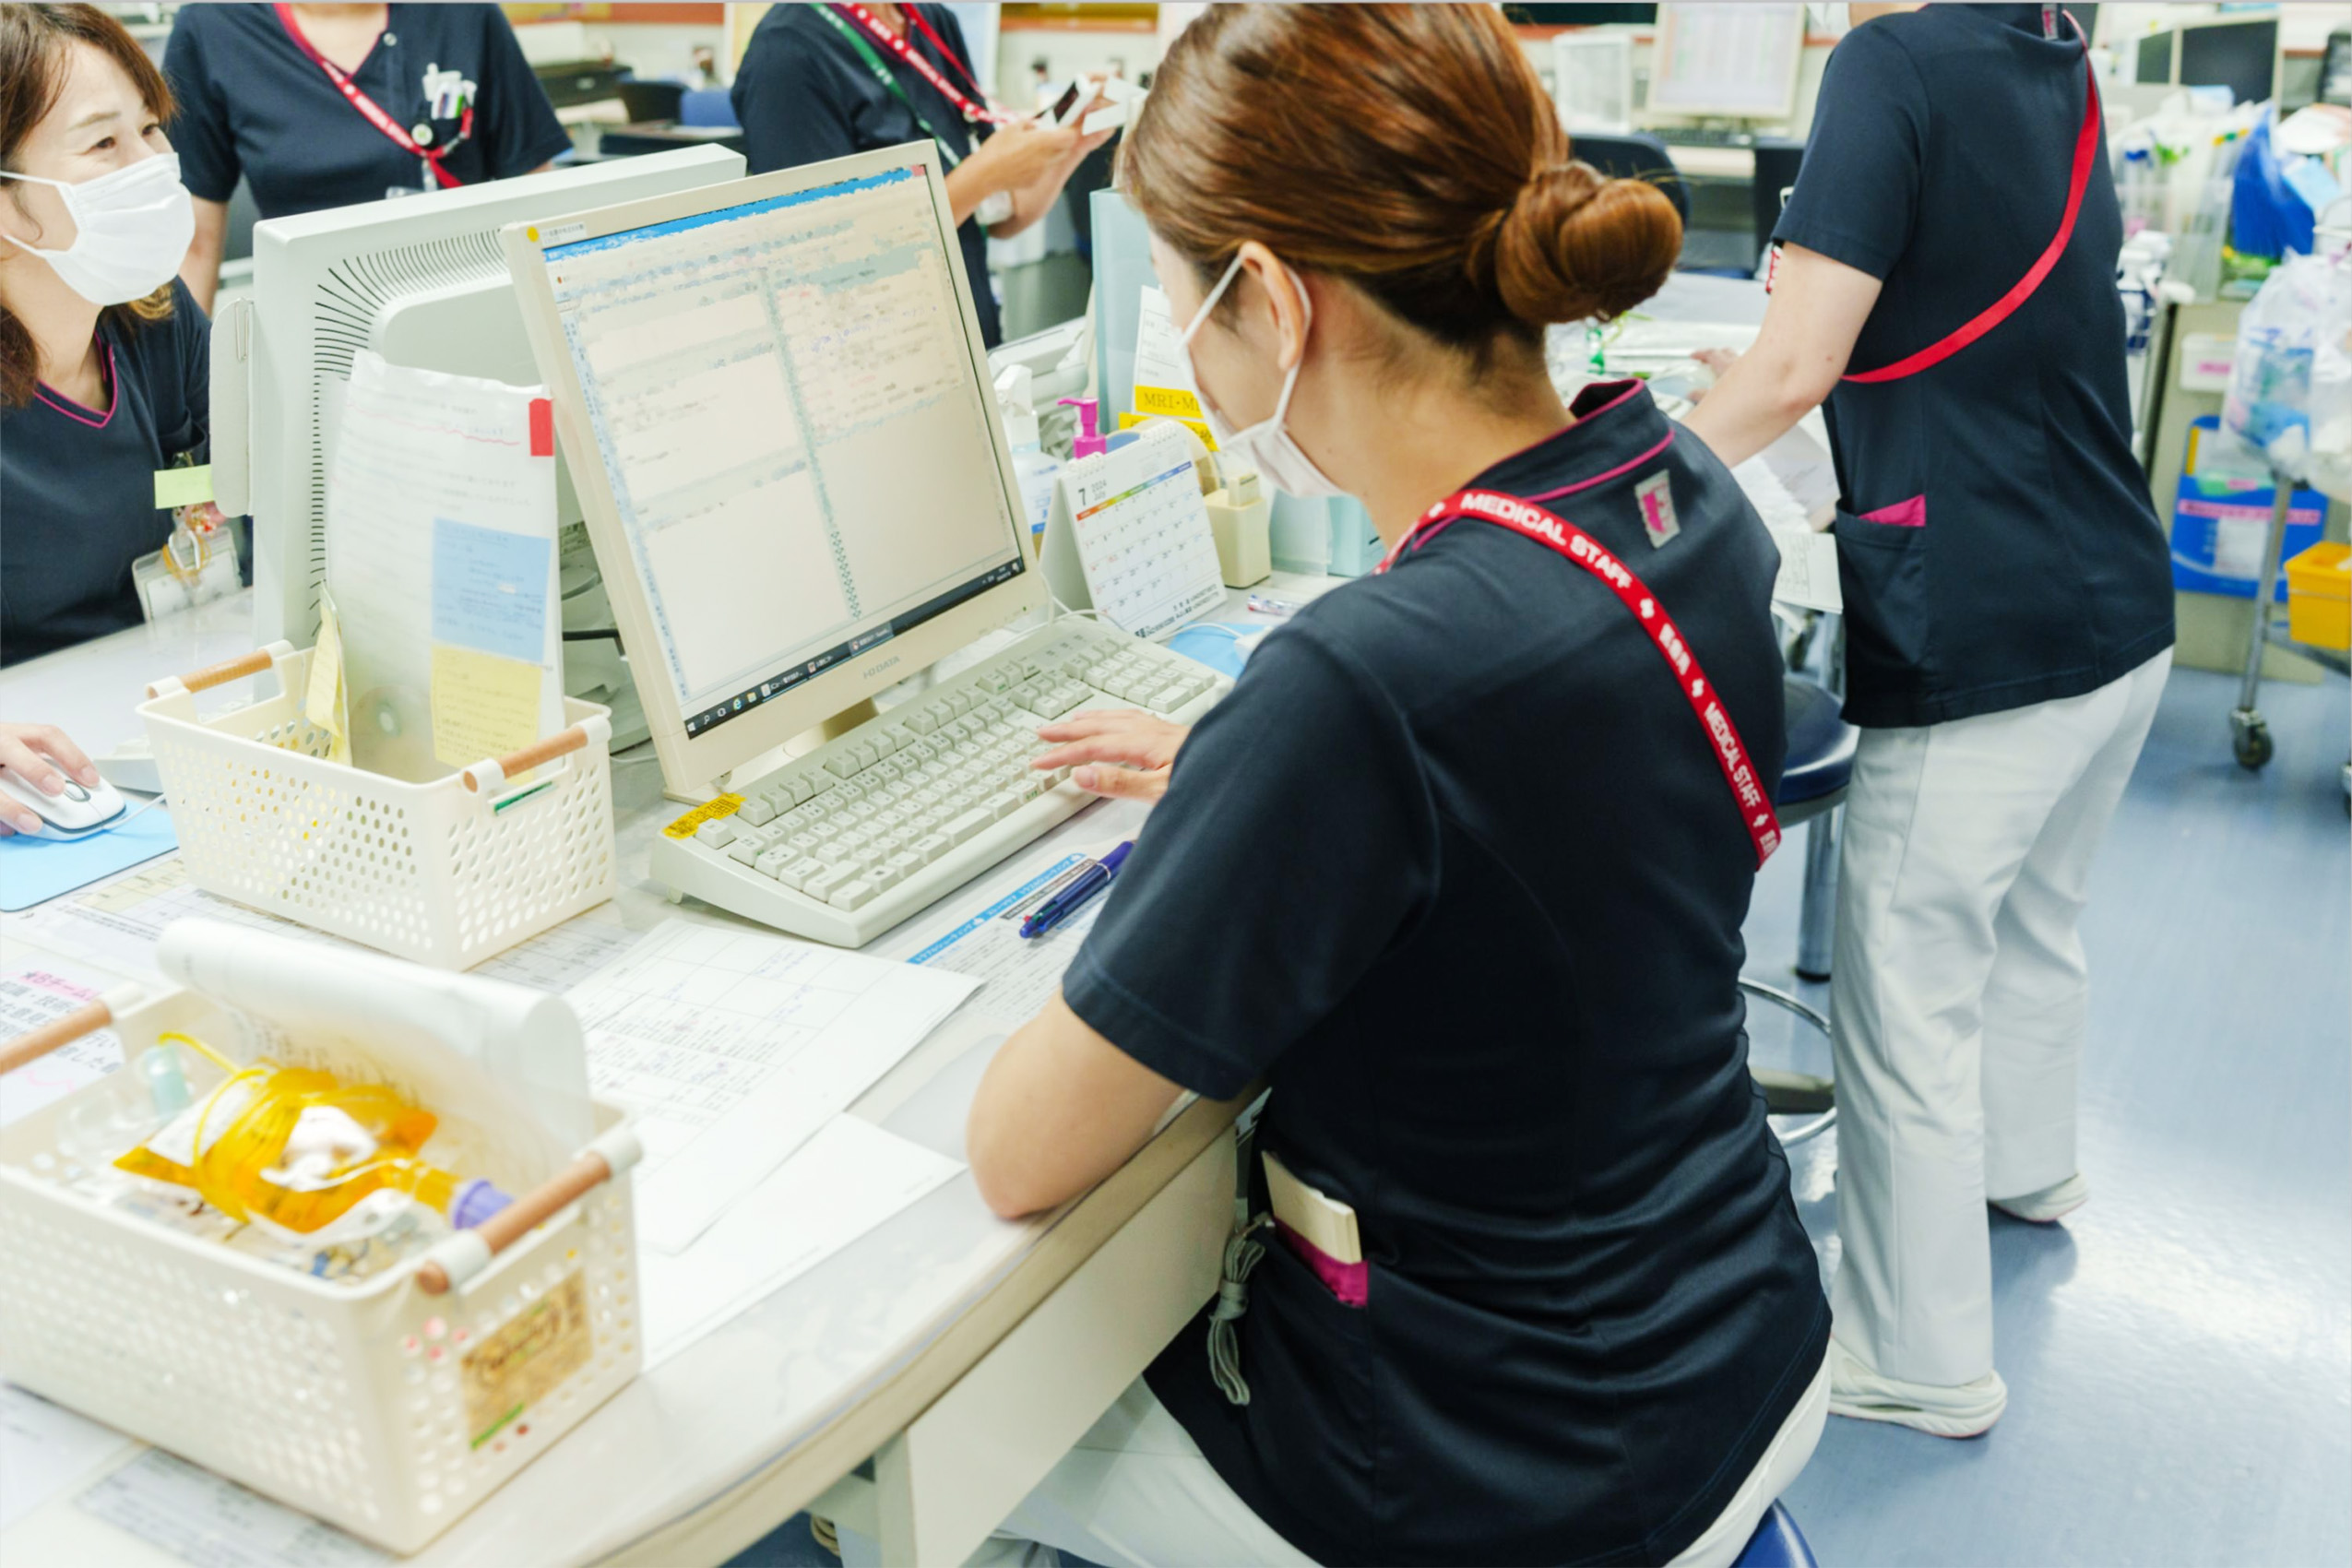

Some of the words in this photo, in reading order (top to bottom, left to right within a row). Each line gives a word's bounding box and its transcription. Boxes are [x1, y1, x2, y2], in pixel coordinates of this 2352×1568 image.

[1078, 487, 1087, 506] 7
[1460, 493, 1566, 546] MEDICAL
[1570, 534, 1633, 588] STAFF
[1705, 701, 1741, 772] MEDICAL
[1733, 765, 1762, 808] STAFF
